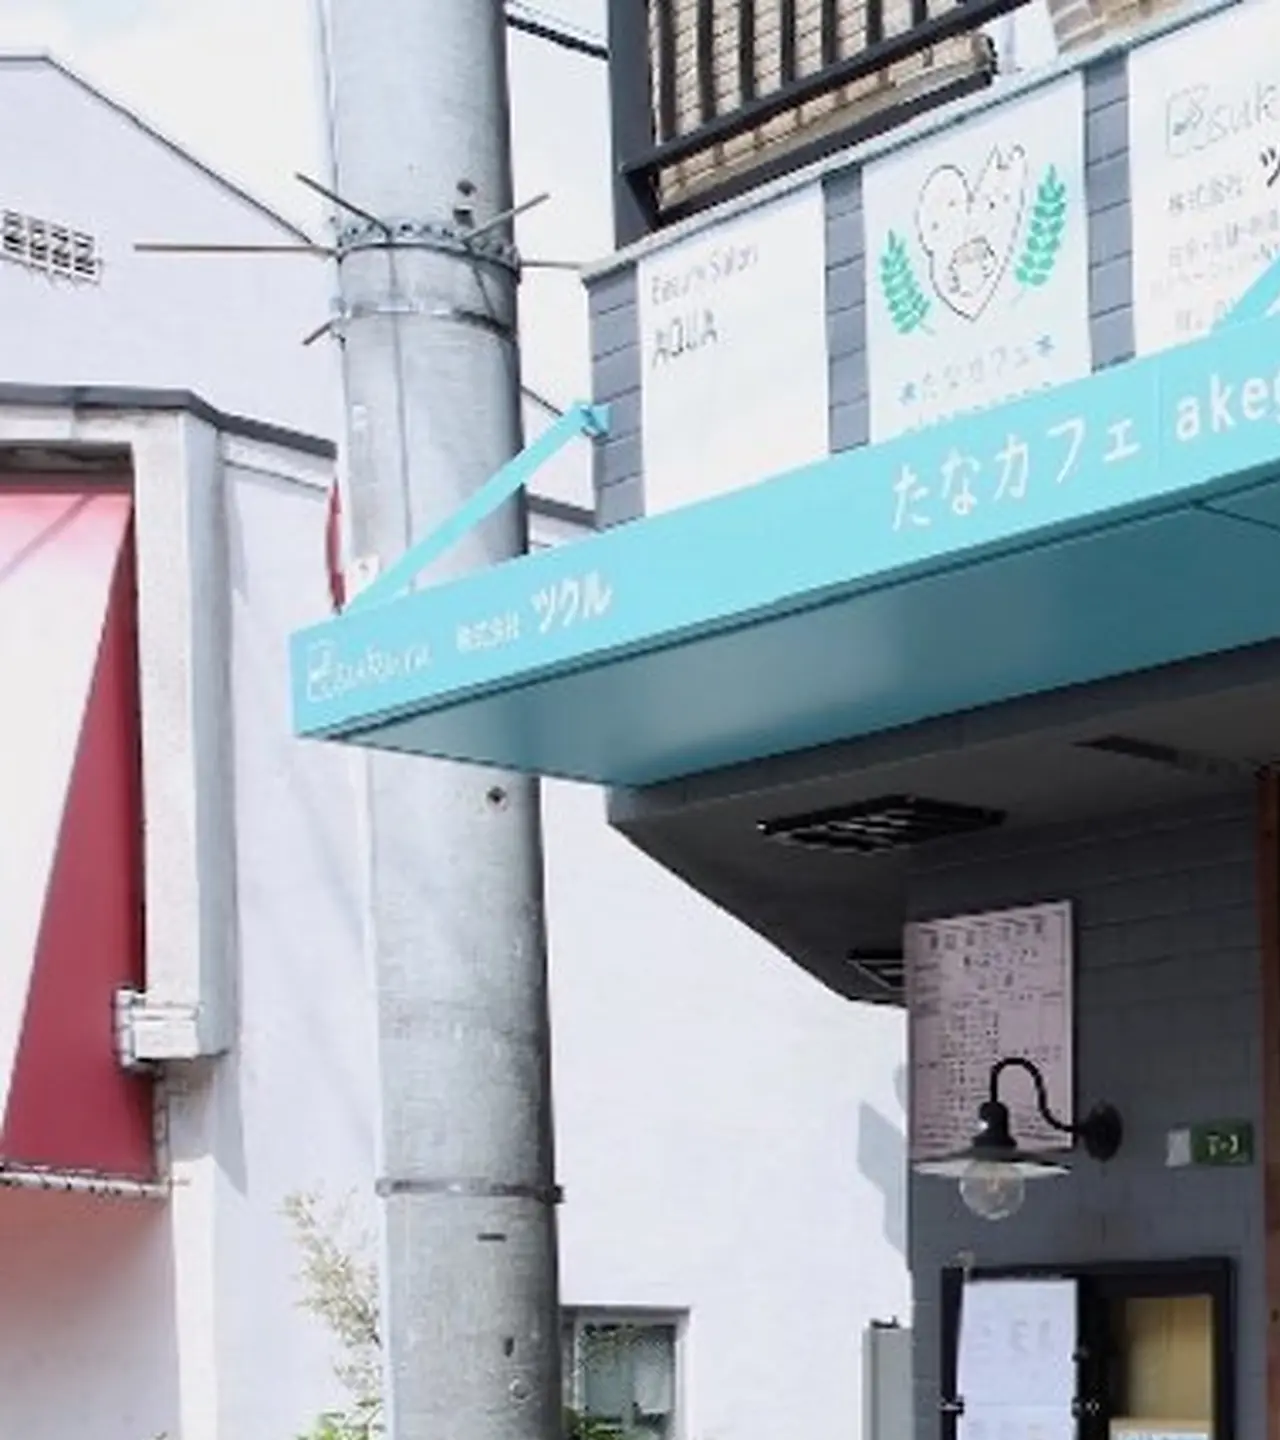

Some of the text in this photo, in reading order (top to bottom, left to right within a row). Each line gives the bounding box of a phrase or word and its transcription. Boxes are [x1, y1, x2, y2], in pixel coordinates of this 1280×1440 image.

[891, 414, 1142, 533] たなカフェ
[530, 569, 614, 635] ツクル
